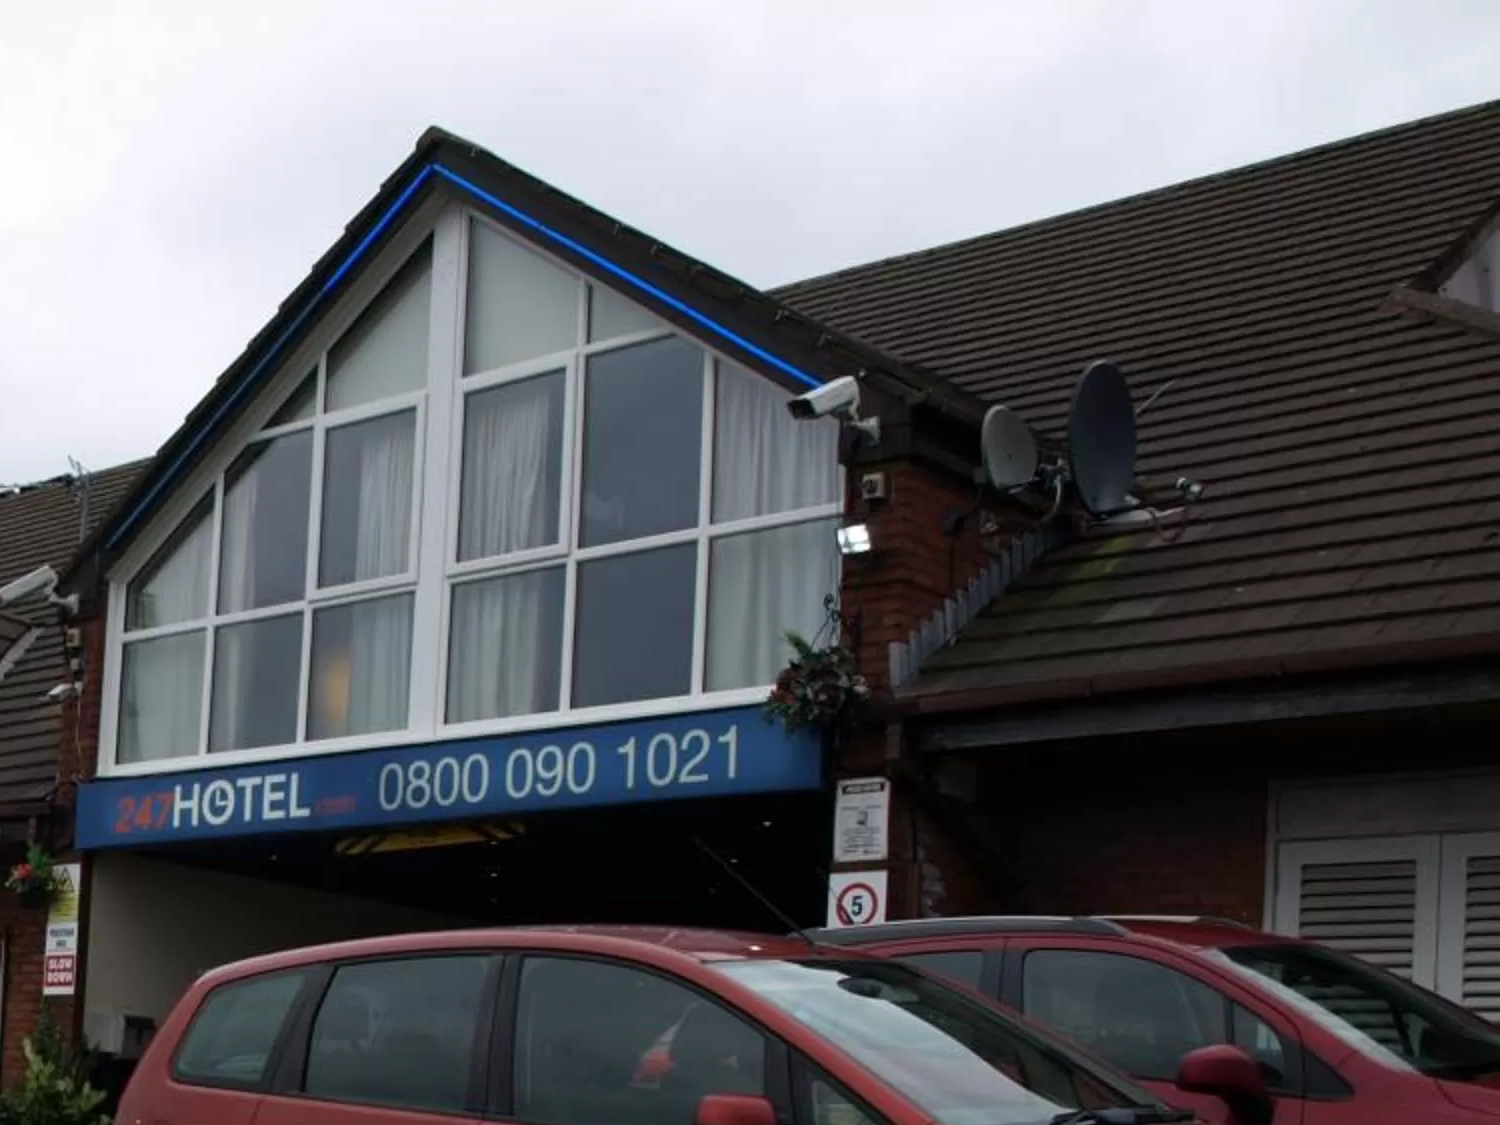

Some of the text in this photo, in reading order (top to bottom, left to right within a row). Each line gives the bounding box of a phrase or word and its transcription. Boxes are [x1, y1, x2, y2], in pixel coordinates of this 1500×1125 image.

[379, 753, 489, 811] 0800
[505, 742, 596, 799] 090
[617, 725, 737, 789] 1021
[851, 896, 864, 917] 5
